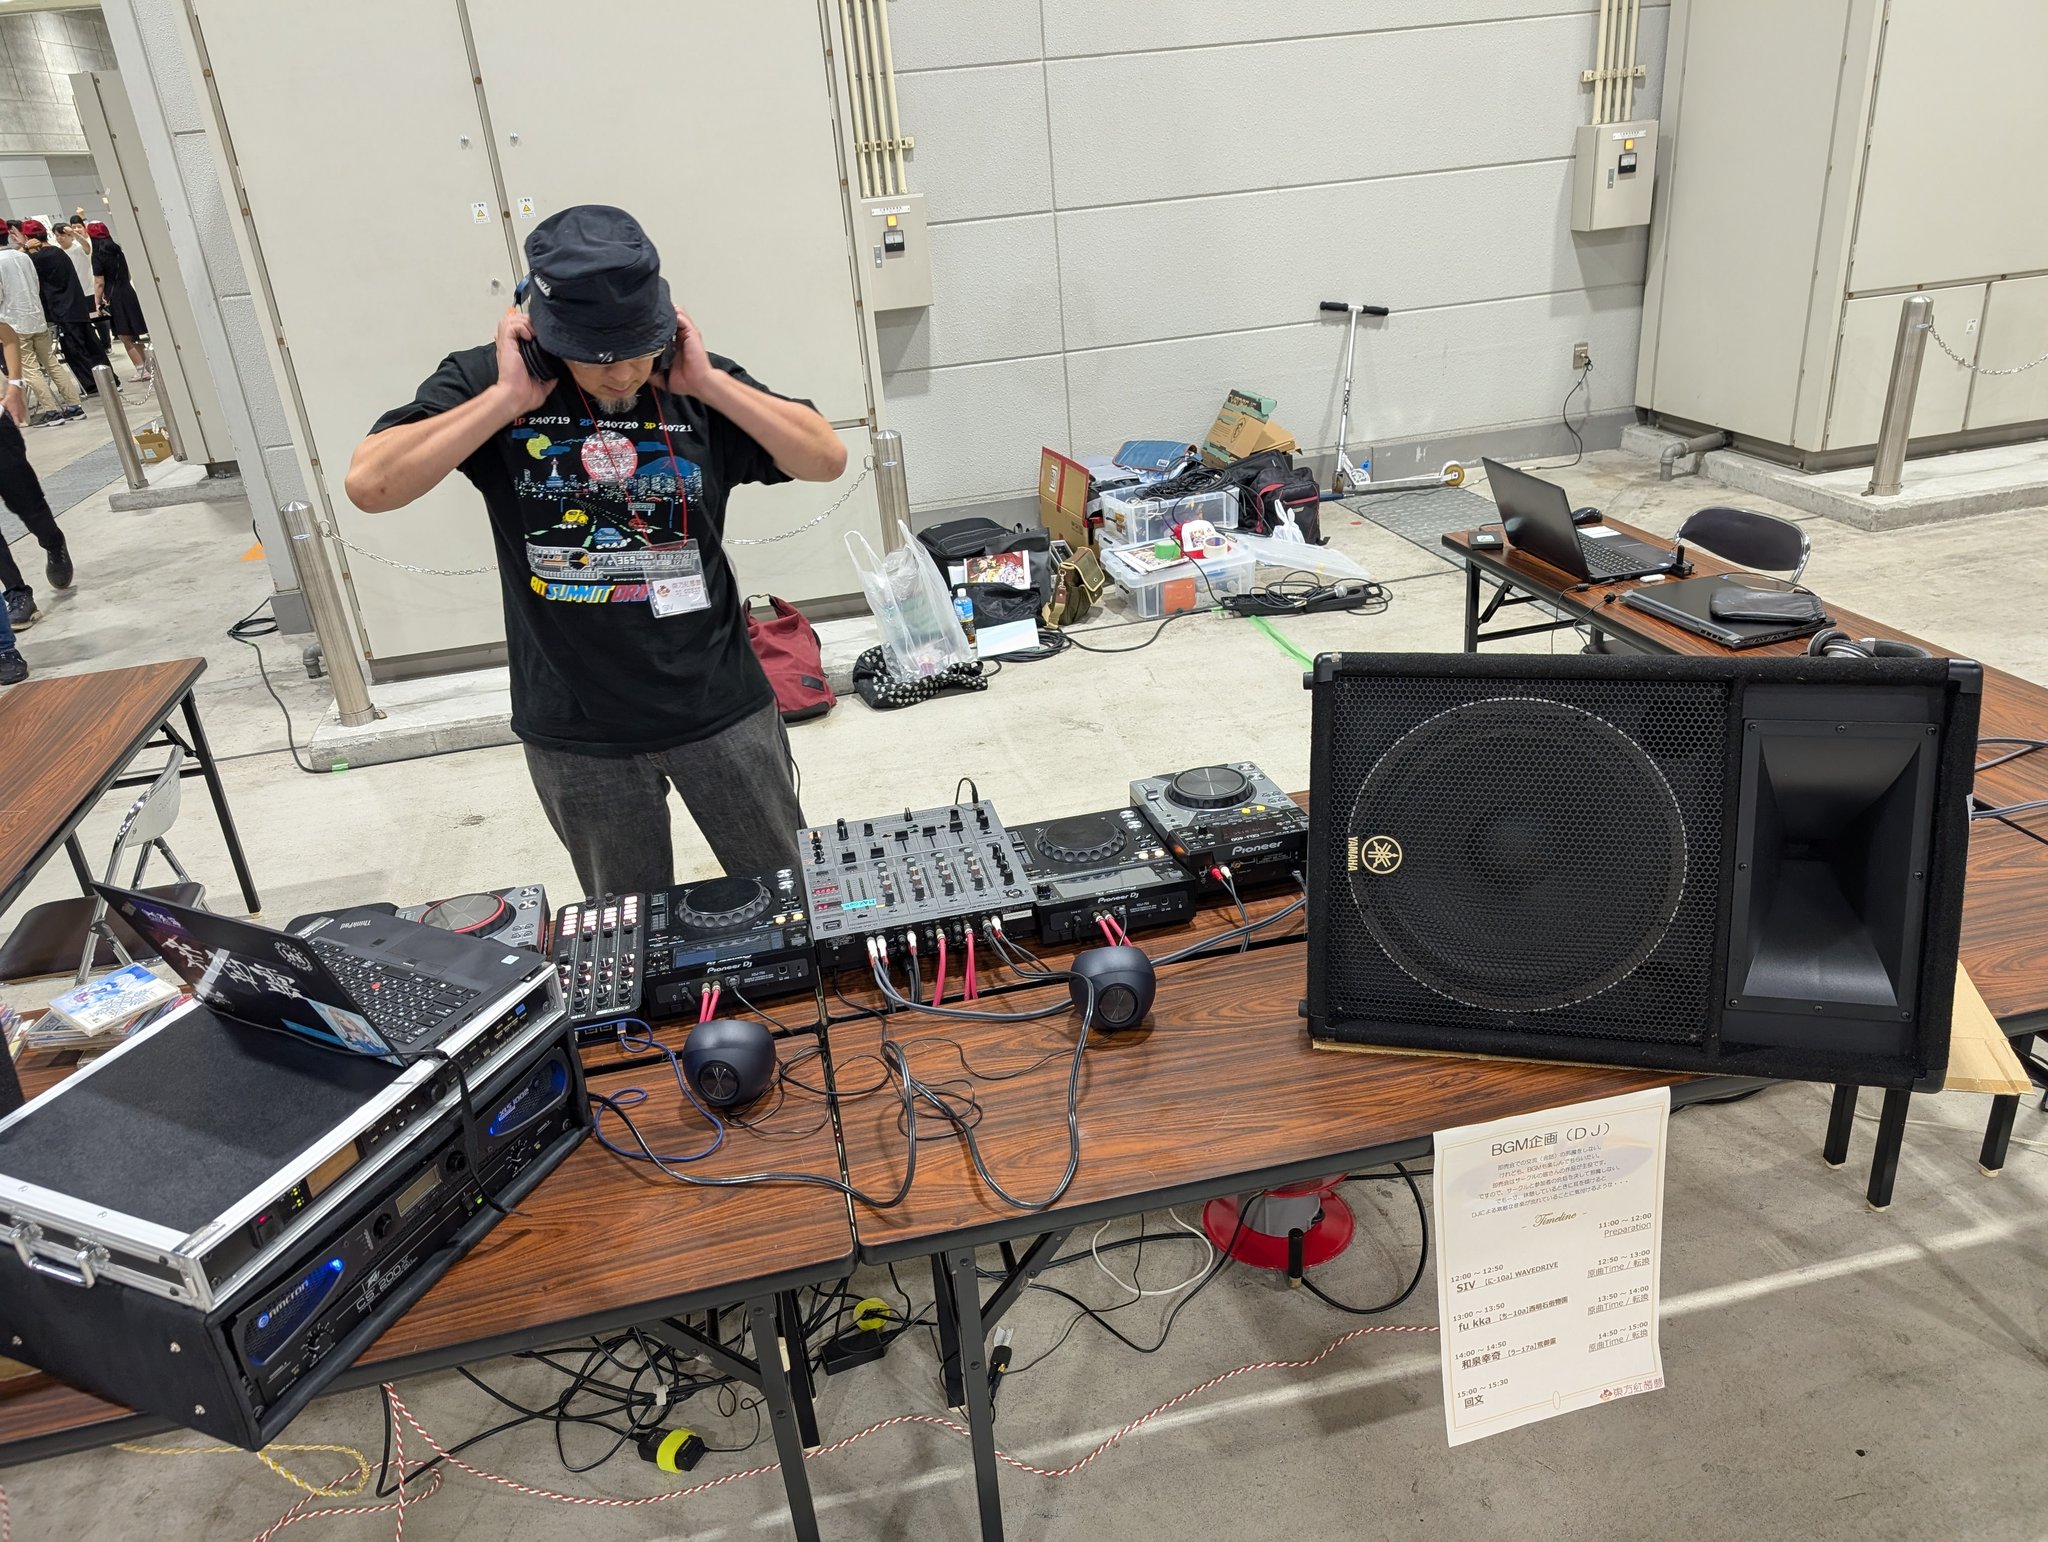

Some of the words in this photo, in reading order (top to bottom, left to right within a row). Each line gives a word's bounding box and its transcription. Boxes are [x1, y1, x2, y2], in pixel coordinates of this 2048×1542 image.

[528, 416, 570, 425] 240719
[579, 418, 594, 426] 2P
[596, 419, 639, 429] 240720
[643, 422, 656, 430] 3P
[530, 575, 548, 597] BIT
[546, 583, 616, 603] SUMMIT
[1232, 841, 1283, 855] Pioneer
[1347, 836, 1358, 871] YAMAHA
[1097, 894, 1129, 904] Pioneer
[340, 920, 371, 930] ThinkPad
[706, 963, 741, 974] Pioneer
[1532, 1212, 1577, 1228] Timeline
[1598, 1219, 1620, 1229] 11:00
[1631, 1212, 1652, 1222] 12:00
[1604, 1222, 1652, 1238] Preparation
[1598, 1256, 1618, 1266] 12:50
[1630, 1249, 1650, 1259] 13:00
[1450, 1272, 1472, 1283] 12:00
[1483, 1264, 1504, 1275] 12:50
[1456, 1280, 1476, 1293] SIV
[1515, 1261, 1559, 1278] WAVEDRIVE
[355, 1289, 375, 1311] CS
[1598, 1292, 1618, 1302] 13:50
[1629, 1285, 1649, 1295] 14:00
[1453, 1311, 1474, 1322] 13:00
[1484, 1302, 1505, 1313] 13:50
[1598, 1329, 1618, 1339] 14:50
[1628, 1321, 1648, 1331] 15:00
[1455, 1349, 1475, 1360] 14:00
[1486, 1340, 1507, 1351] 14:50
[1457, 1388, 1478, 1398] 15:00
[1488, 1378, 1509, 1389] 15:30
[1464, 1394, 1485, 1409] 回文
